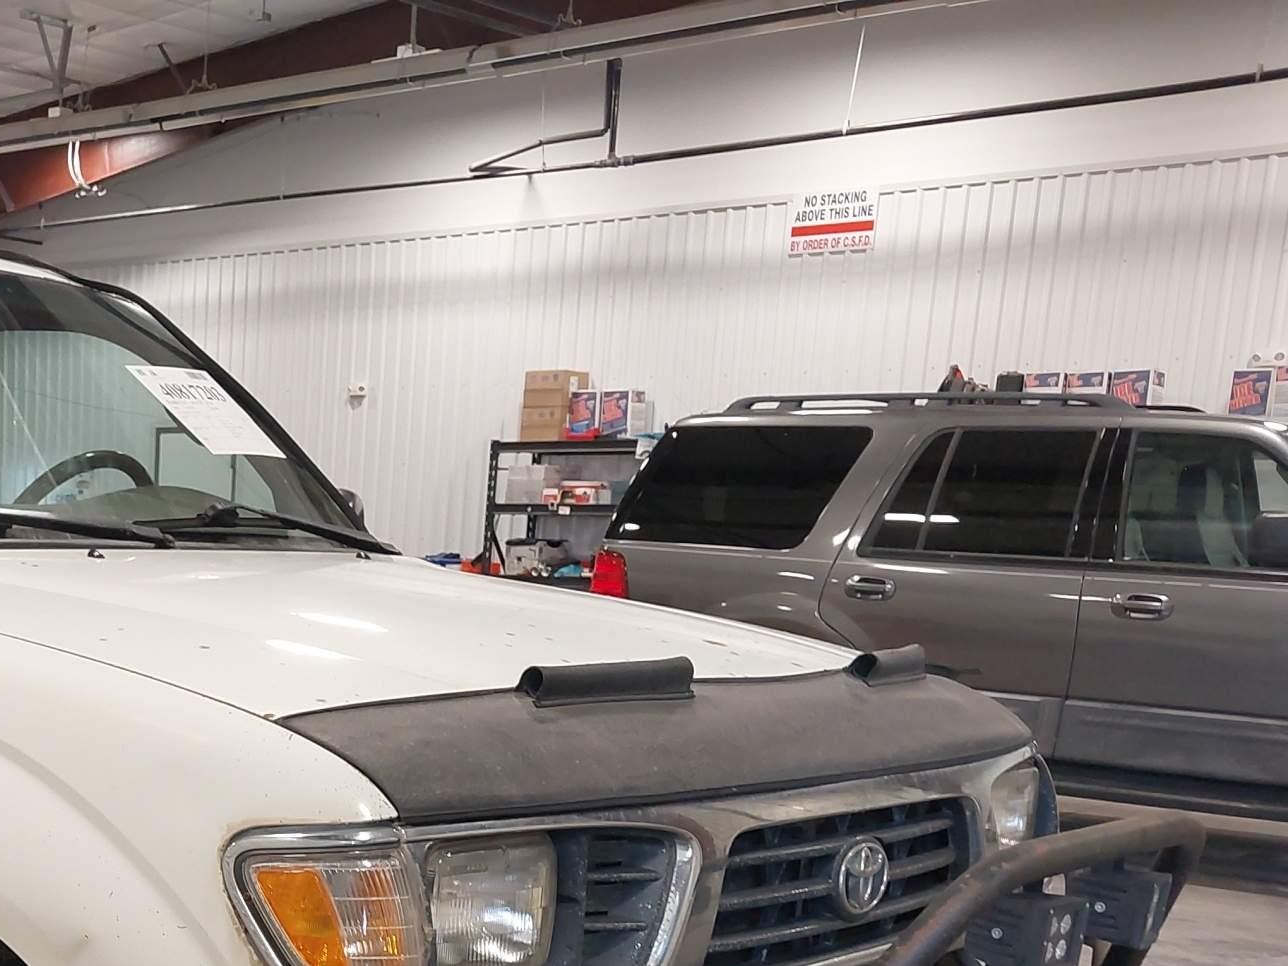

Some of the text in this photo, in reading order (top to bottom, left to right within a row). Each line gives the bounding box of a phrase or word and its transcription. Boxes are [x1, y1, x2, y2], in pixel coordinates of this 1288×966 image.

[804, 190, 867, 208] NO STACKING
[795, 204, 874, 223] ABOVE THIS LINE
[790, 241, 800, 252] BY
[802, 239, 828, 250] ORDER
[831, 237, 842, 249] OF
[159, 383, 228, 402] 40817203
